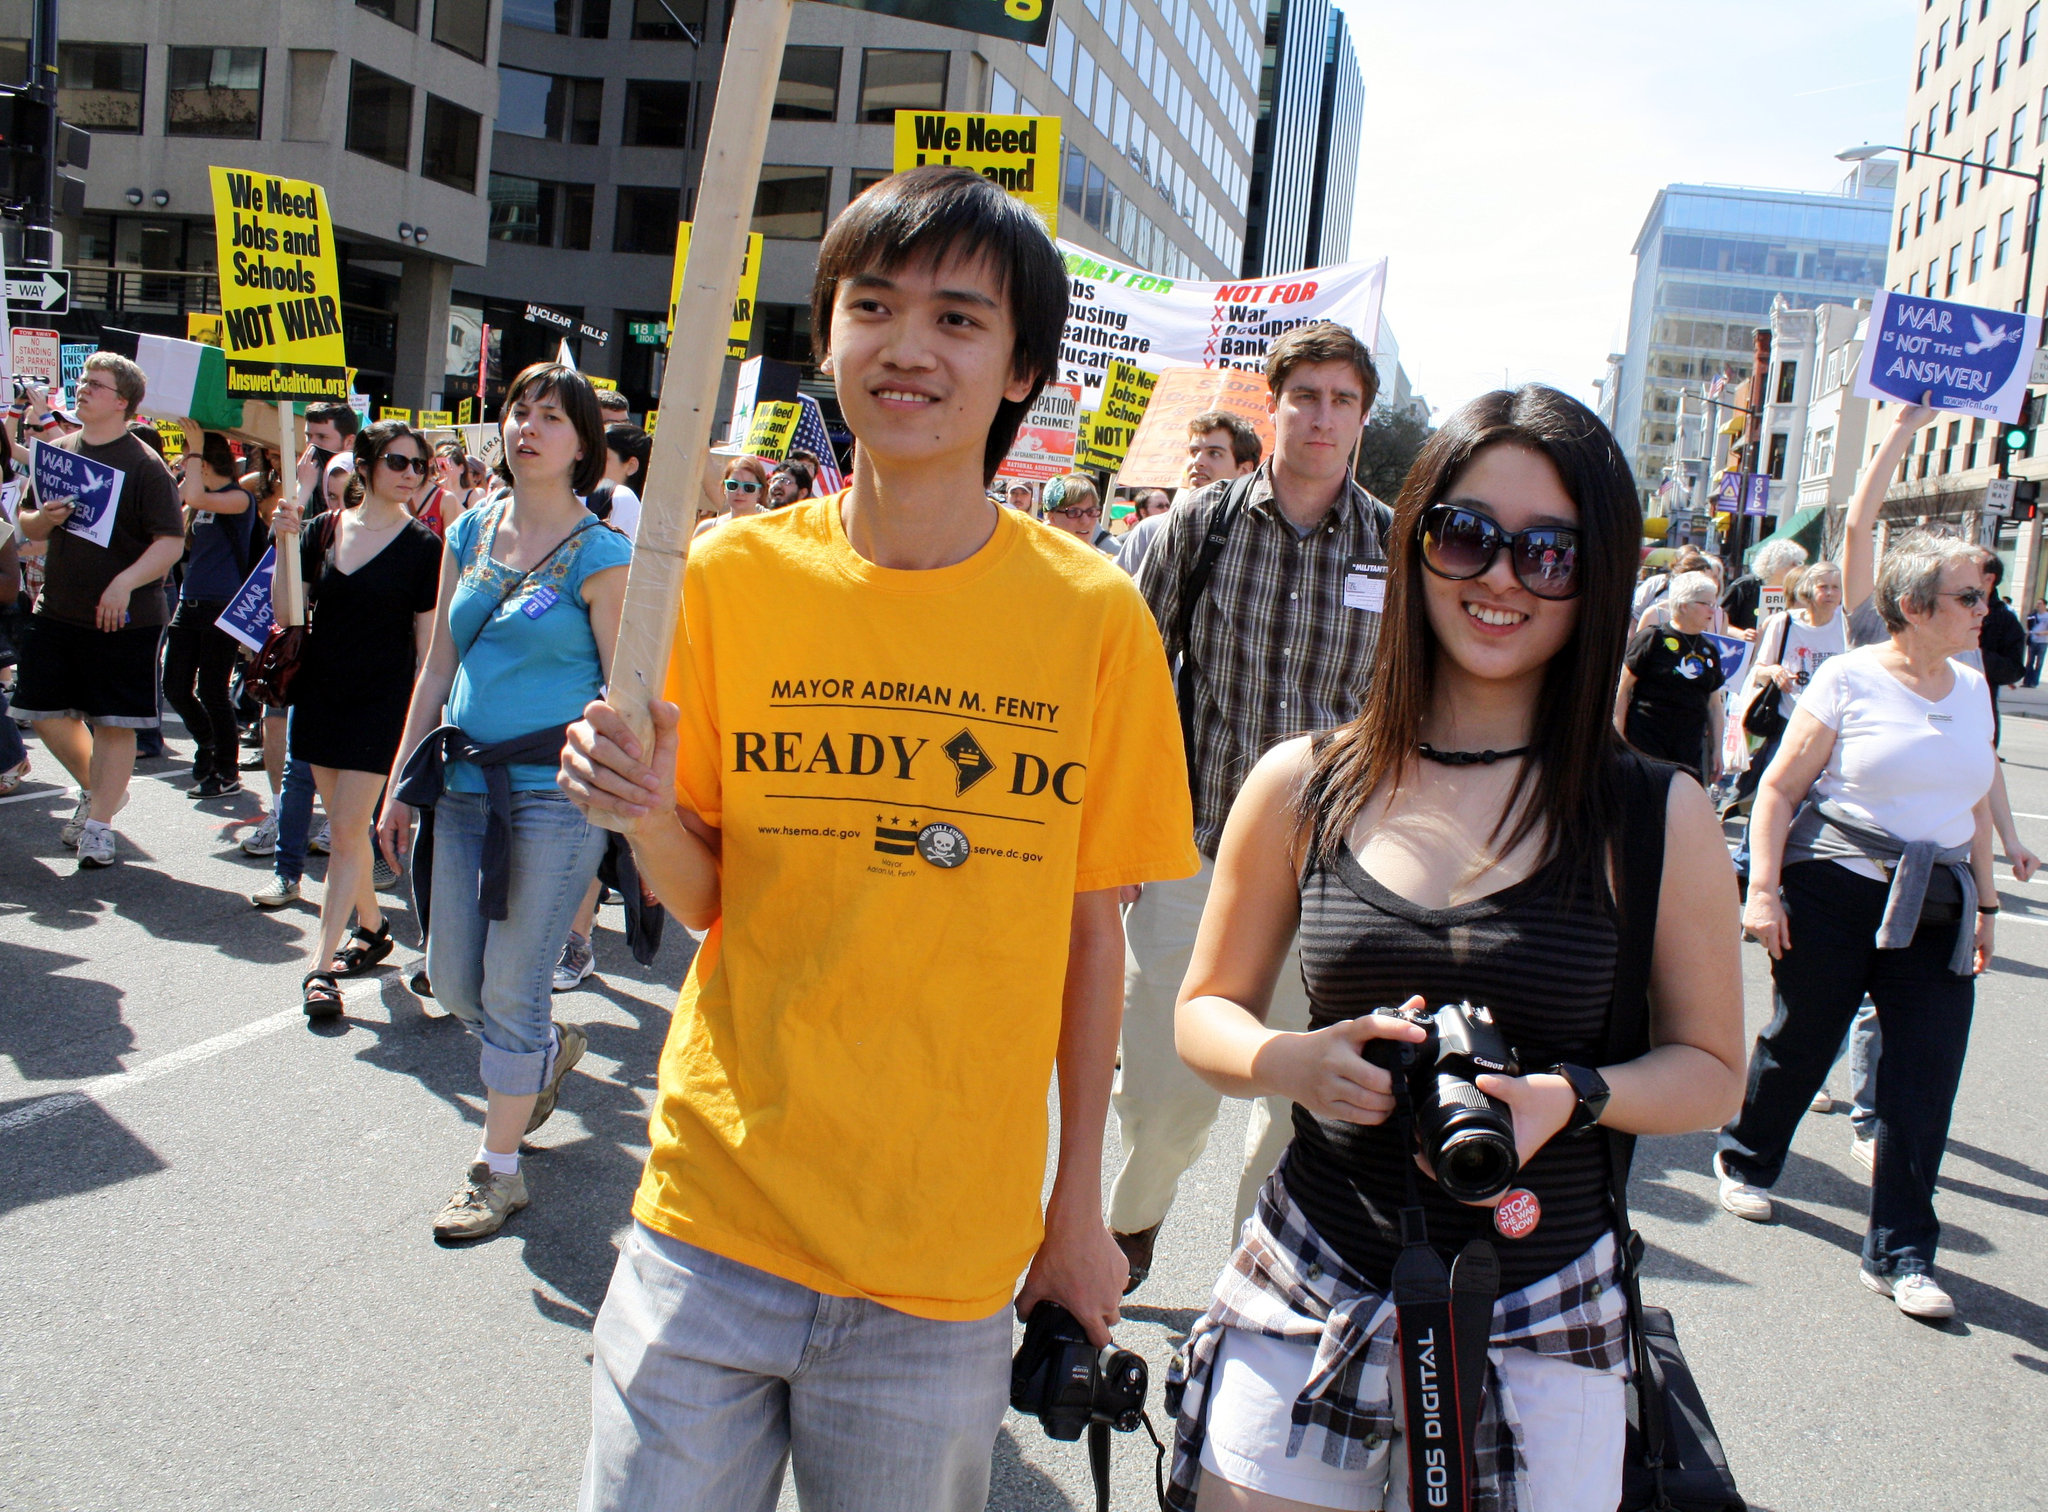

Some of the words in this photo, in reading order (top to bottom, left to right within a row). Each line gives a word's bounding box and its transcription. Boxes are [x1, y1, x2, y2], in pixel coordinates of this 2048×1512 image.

[915, 116, 961, 151] We
[966, 117, 1037, 154] Need
[227, 173, 263, 212] We
[266, 179, 318, 220] Need
[232, 212, 279, 252] Jobs
[283, 224, 321, 258] and
[233, 251, 316, 294] Schools
[1062, 253, 1123, 283] ONEY
[1125, 274, 1174, 294] FOR
[20, 285, 47, 297] WAY
[1070, 279, 1095, 300] bs
[1215, 284, 1268, 303] NOT
[1268, 282, 1318, 304] FOR
[734, 298, 751, 321] AR
[1068, 302, 1128, 331] ousing
[1228, 305, 1268, 322] War
[1898, 304, 1952, 334] WAR
[225, 304, 276, 352] NOT
[277, 295, 342, 342] WAR
[526, 304, 572, 328] NUCLEAR
[580, 324, 608, 342] KILLS
[633, 324, 649, 335] 18
[19, 346, 52, 356] STANDING
[63, 344, 93, 354] VETERANS
[640, 335, 654, 343] 1100
[1062, 324, 1150, 353] ealthcare
[1882, 330, 1894, 342] IS
[1896, 334, 1932, 354] NOT
[1933, 342, 1963, 357] THE
[15, 356, 25, 364] OR
[28, 358, 56, 366] PARKING
[22, 366, 50, 376] ANYTIME
[64, 355, 82, 365] THIS
[228, 366, 346, 398] AnswerCoalition.org
[1116, 364, 1135, 384] We
[1136, 371, 1158, 390] Nee
[1886, 356, 1992, 393] ANSWER!
[1110, 382, 1137, 404] Jobs
[1031, 396, 1076, 416] UPATION
[1080, 412, 1090, 425] nd
[1106, 400, 1142, 425] Schoo
[156, 420, 183, 433] Schoo
[769, 421, 789, 434] and
[1032, 416, 1074, 430] CRIME!
[480, 436, 500, 462] ETERA
[748, 432, 780, 448] Schools
[1094, 426, 1123, 447] NOT
[42, 450, 74, 476] WAR
[35, 468, 42, 476] IS
[42, 472, 62, 489] NOT
[62, 480, 80, 494] THE
[1753, 478, 1763, 508] GOLD
[42, 488, 96, 522] ANER!
[232, 584, 268, 620] WAR
[1765, 596, 1786, 604] BRI
[246, 624, 255, 633] IS
[252, 602, 274, 628] NOT
[771, 679, 854, 698] MAYOR
[861, 681, 951, 706] ADRIAN
[959, 690, 986, 712] M.
[995, 696, 1059, 723] FENTY
[731, 732, 930, 780] READY
[1006, 752, 1087, 805] DC
[758, 826, 860, 840] www.hsema.dc.gov
[970, 846, 1043, 862] .serve.dc.gov
[919, 828, 931, 841] WHY
[949, 829, 962, 841] FOR
[960, 840, 968, 854] OIL?
[882, 858, 902, 868] Mayor
[1474, 1056, 1504, 1070] Canon
[1500, 1195, 1529, 1220] STOP
[1501, 1216, 1517, 1229] THE
[1516, 1205, 1536, 1220] WAR
[1511, 1215, 1533, 1234] NOW
[1418, 1328, 1442, 1438] DIGITAL
[1425, 1448, 1447, 1507] EOS
